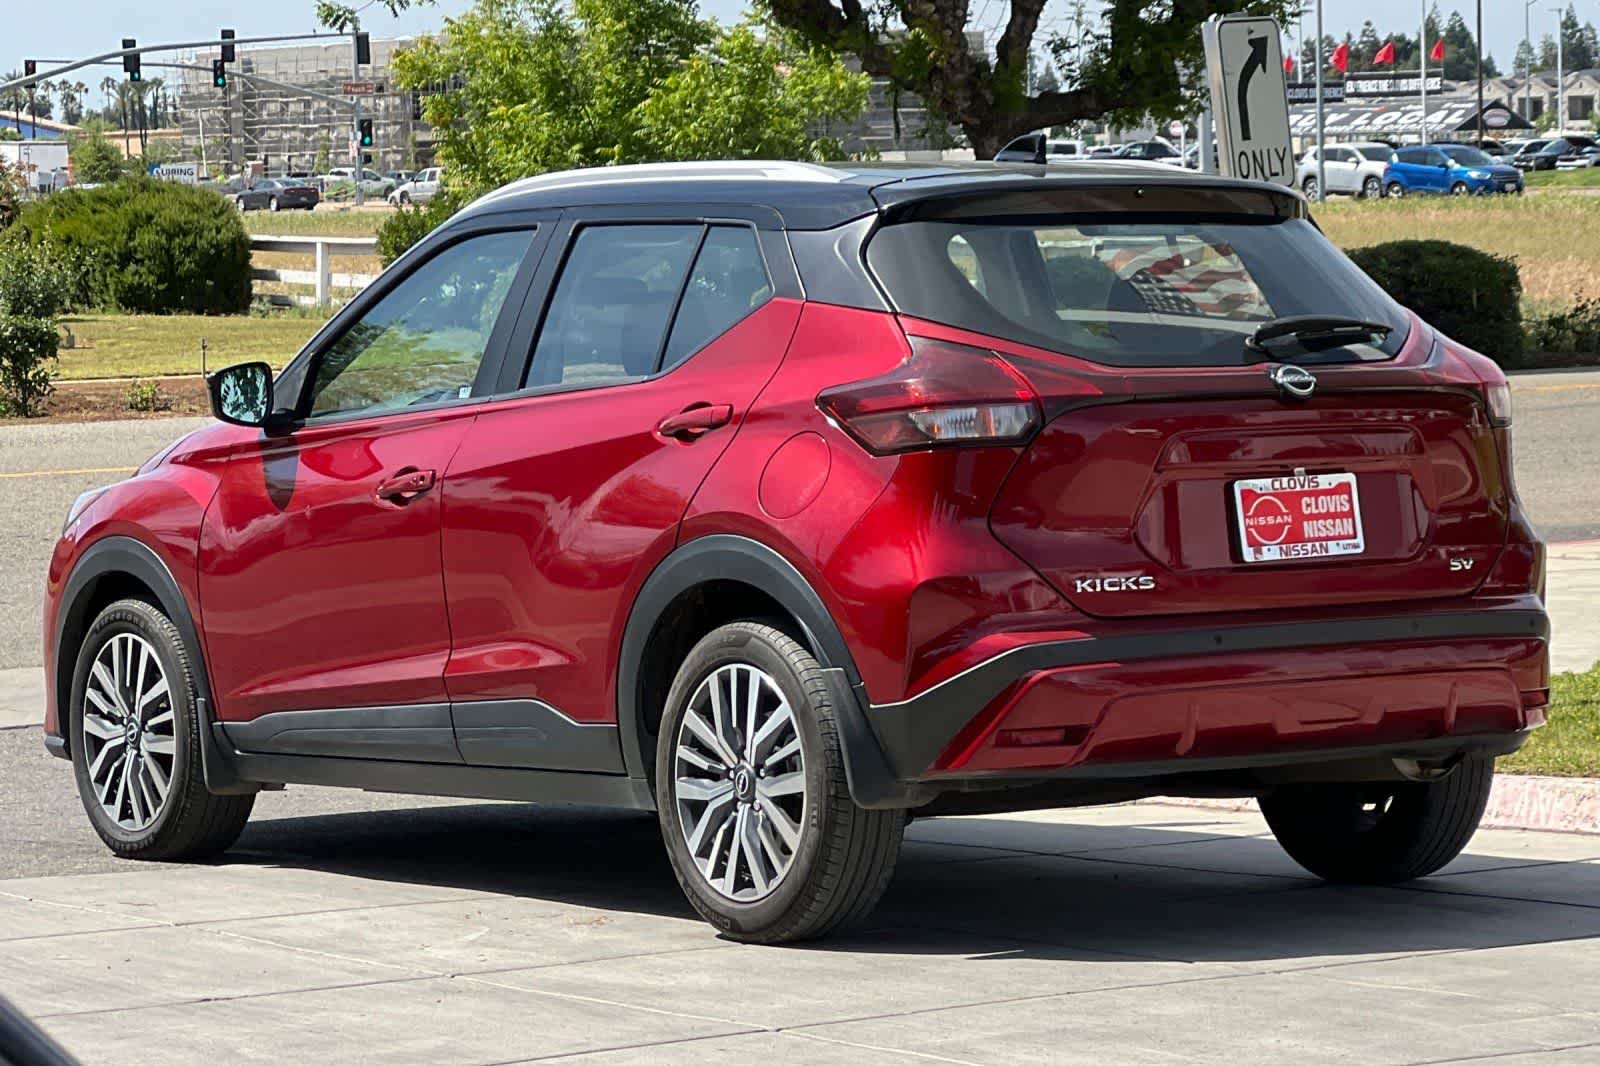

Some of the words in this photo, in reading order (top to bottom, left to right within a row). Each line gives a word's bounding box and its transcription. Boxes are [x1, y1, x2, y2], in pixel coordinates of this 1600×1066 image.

[1238, 147, 1286, 180] ONLY
[1271, 476, 1319, 490] CLOVIS
[1301, 494, 1350, 514] CLOVIS
[1245, 514, 1292, 526] NISSAN
[1303, 518, 1354, 538] NISSAN
[1279, 543, 1329, 557] NISSAN
[1450, 558, 1474, 571] SV
[1075, 576, 1156, 593] KICKS
